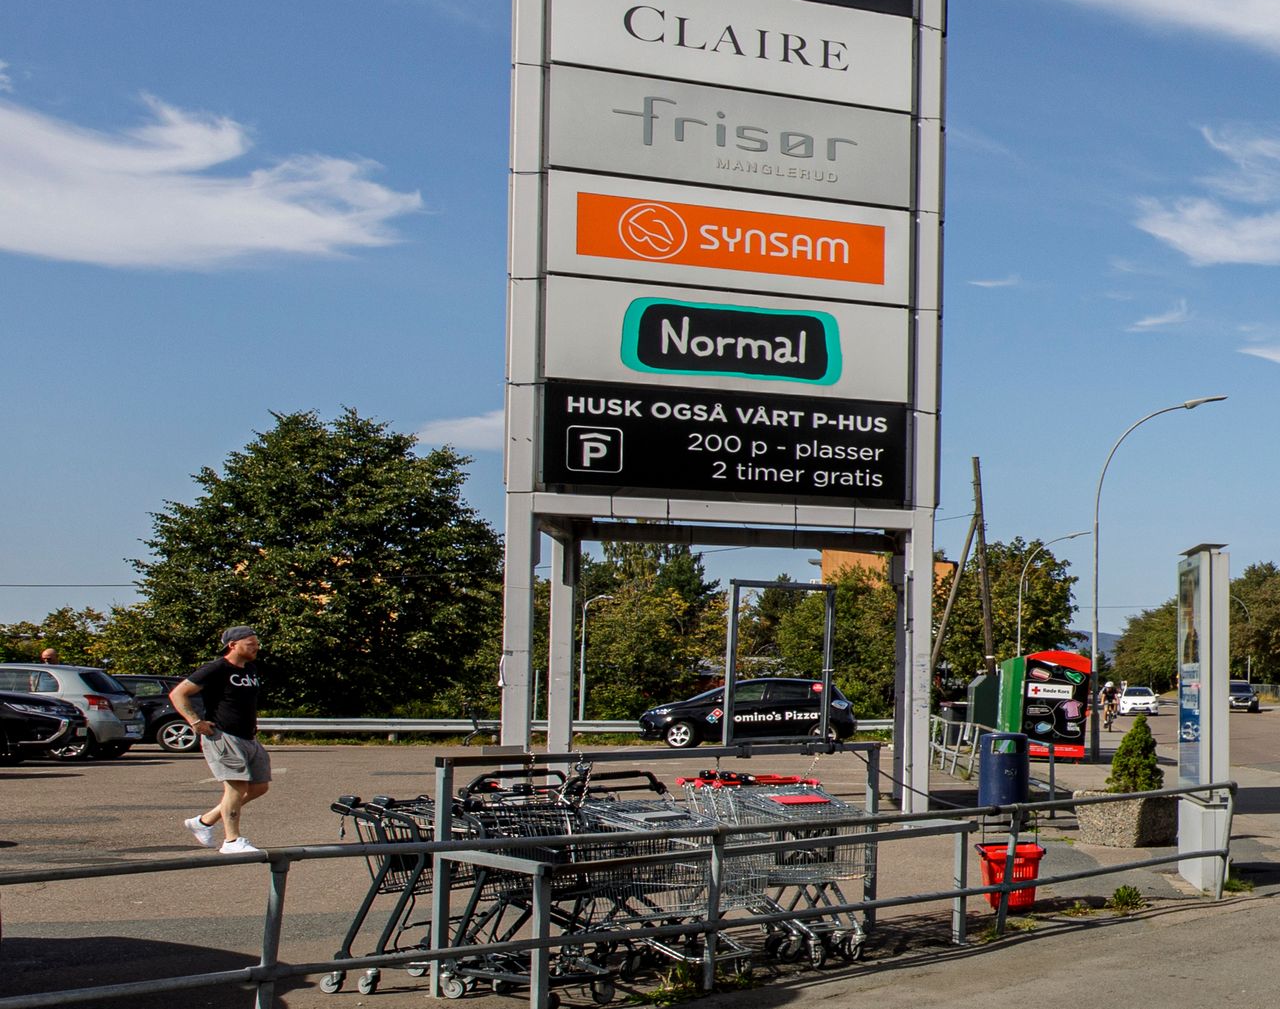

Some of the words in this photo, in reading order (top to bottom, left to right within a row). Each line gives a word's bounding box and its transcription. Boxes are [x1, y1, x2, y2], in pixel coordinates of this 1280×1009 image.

[624, 5, 850, 72] CLAIRE
[612, 96, 858, 162] frisør
[716, 158, 839, 183] MANGLERUD
[699, 224, 849, 264] SYNSAM
[661, 316, 806, 364] Normal
[567, 396, 642, 418] HUSK
[651, 402, 728, 424] OGSÅ
[736, 405, 805, 428] VÅRT
[812, 413, 888, 433] P-HUS
[687, 433, 741, 453] 200
[751, 440, 768, 458] p
[795, 440, 884, 461] plasser
[712, 461, 728, 480] 2
[736, 462, 805, 483] timer
[812, 468, 883, 487] gratis
[734, 712, 782, 722] omino's
[785, 710, 818, 720] Pizza
